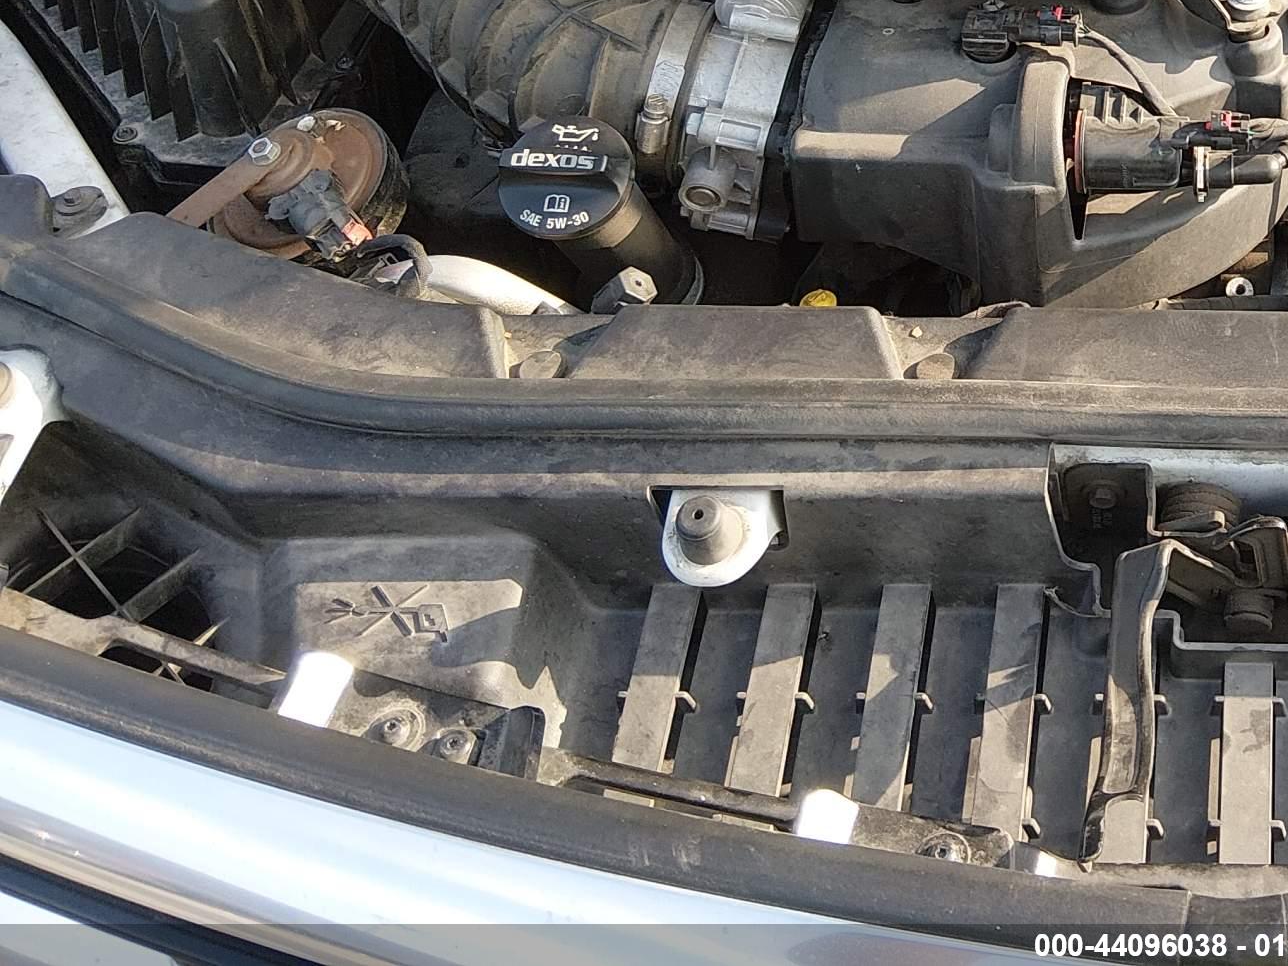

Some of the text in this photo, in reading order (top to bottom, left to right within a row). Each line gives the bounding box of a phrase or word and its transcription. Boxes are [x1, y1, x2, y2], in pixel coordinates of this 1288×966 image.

[510, 148, 599, 170] dexos
[520, 209, 590, 230] SAE 5W-30
